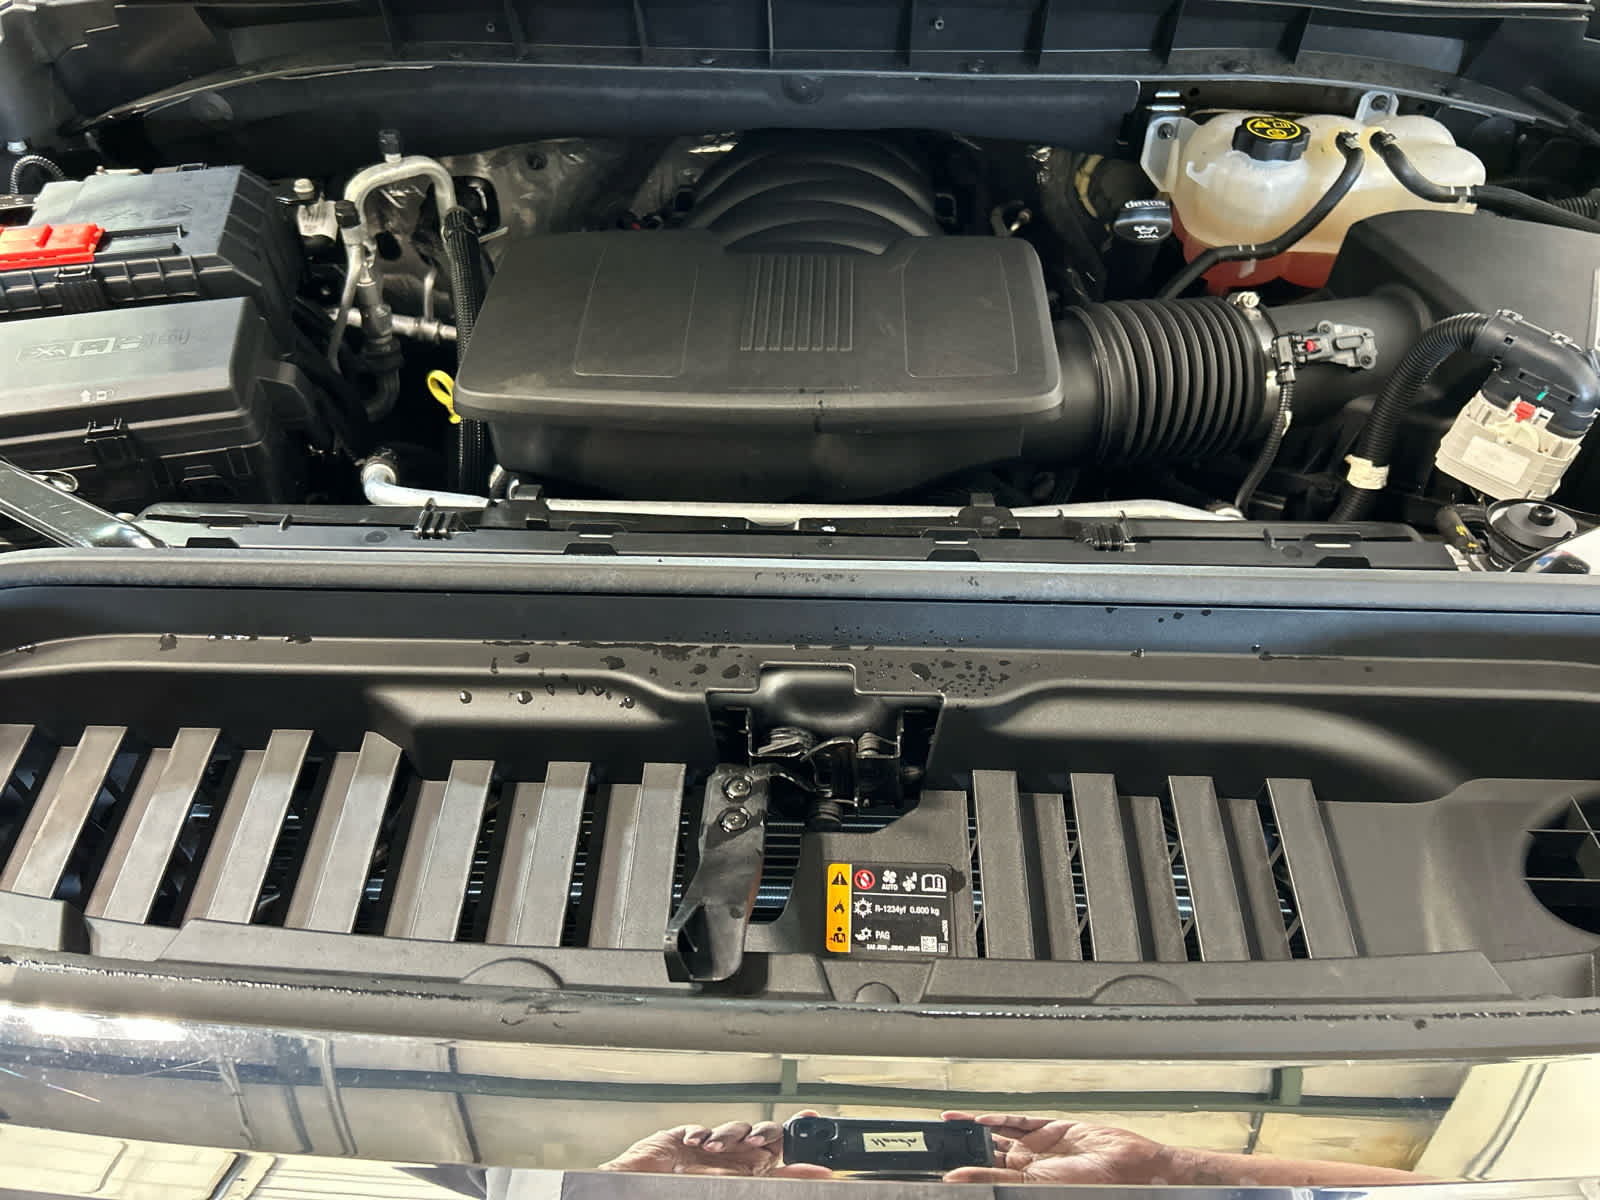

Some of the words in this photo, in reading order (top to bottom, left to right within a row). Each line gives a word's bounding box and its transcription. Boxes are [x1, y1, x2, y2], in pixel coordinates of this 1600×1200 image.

[881, 883, 898, 891] AUTO
[930, 906, 940, 917] kg
[875, 930, 890, 939] PAG
